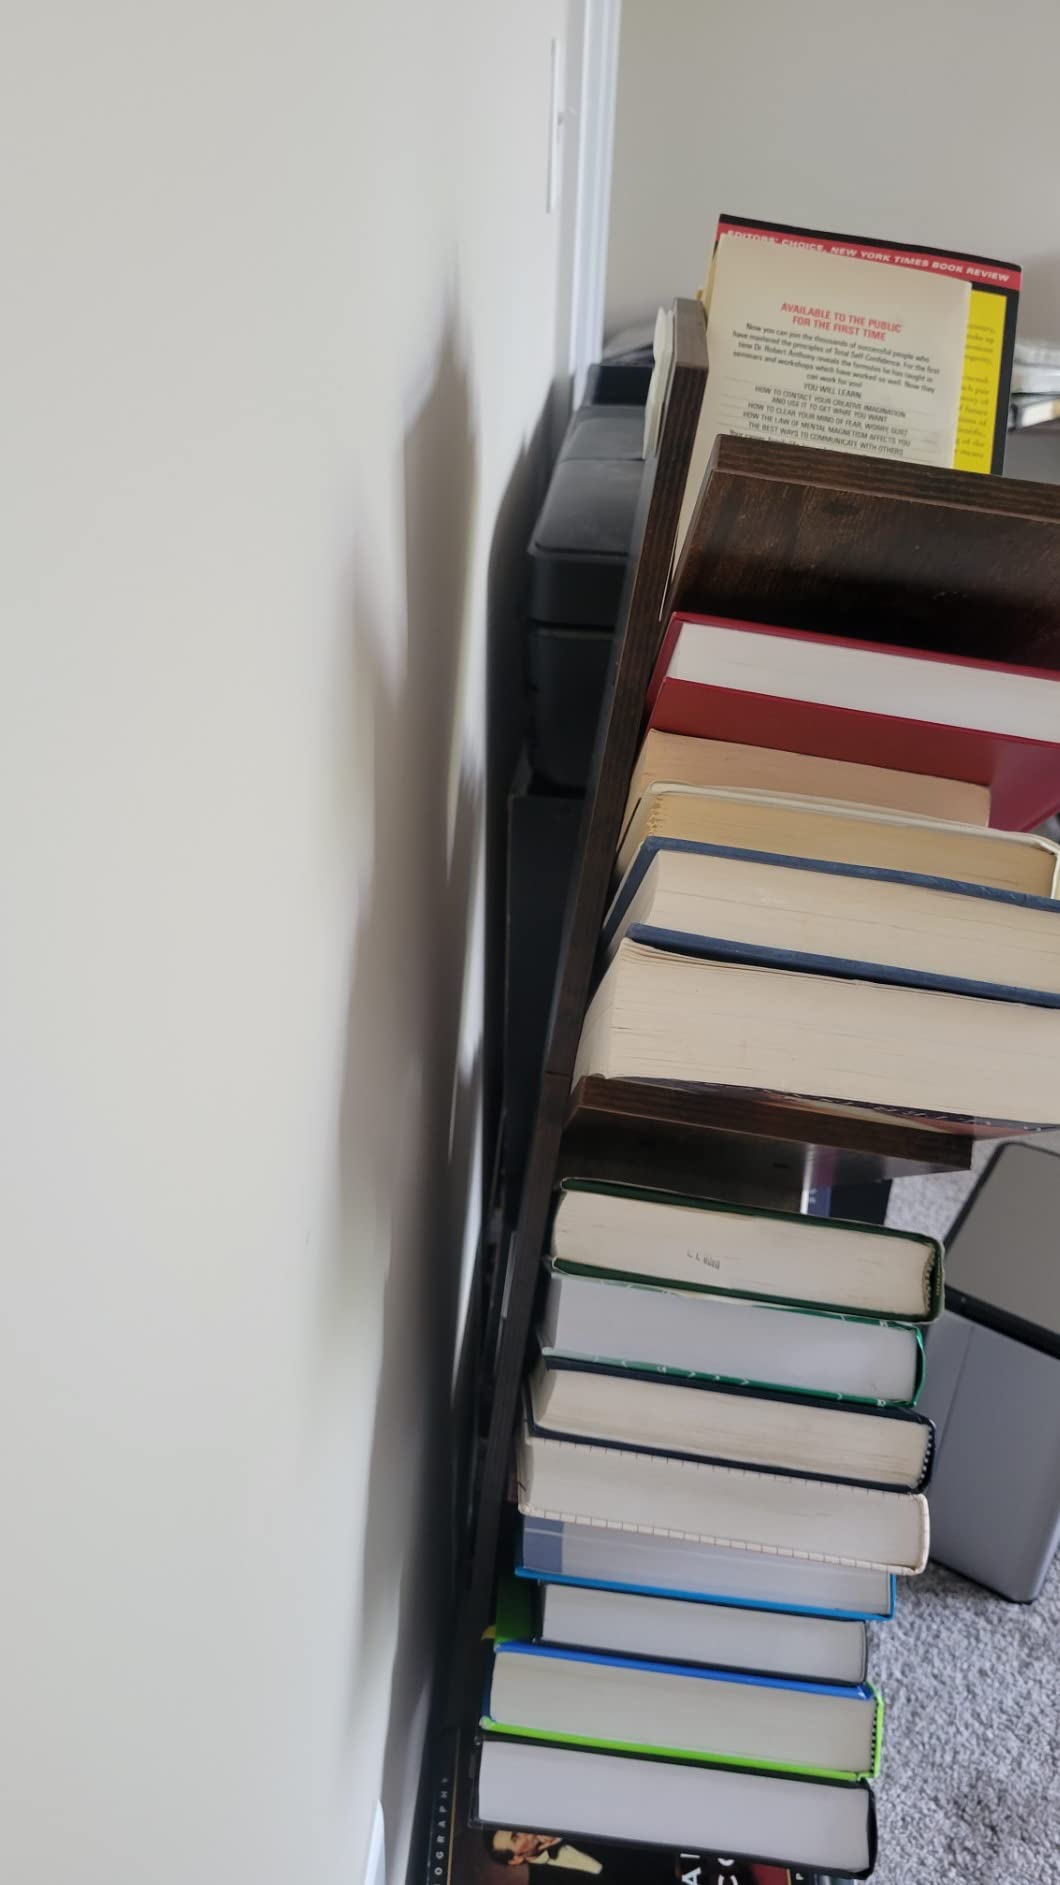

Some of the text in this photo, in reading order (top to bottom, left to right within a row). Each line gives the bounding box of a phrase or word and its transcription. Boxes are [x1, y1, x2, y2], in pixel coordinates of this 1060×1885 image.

[830, 246, 857, 257] NEW
[860, 252, 890, 261] YORK
[894, 257, 929, 267] TIMES
[932, 262, 963, 273] BOOK
[966, 268, 1010, 281] REVIEW
[781, 302, 902, 333] AVAILABLE TO THE PUBLIC
[793, 315, 886, 341] FOR THE FIRST TIME
